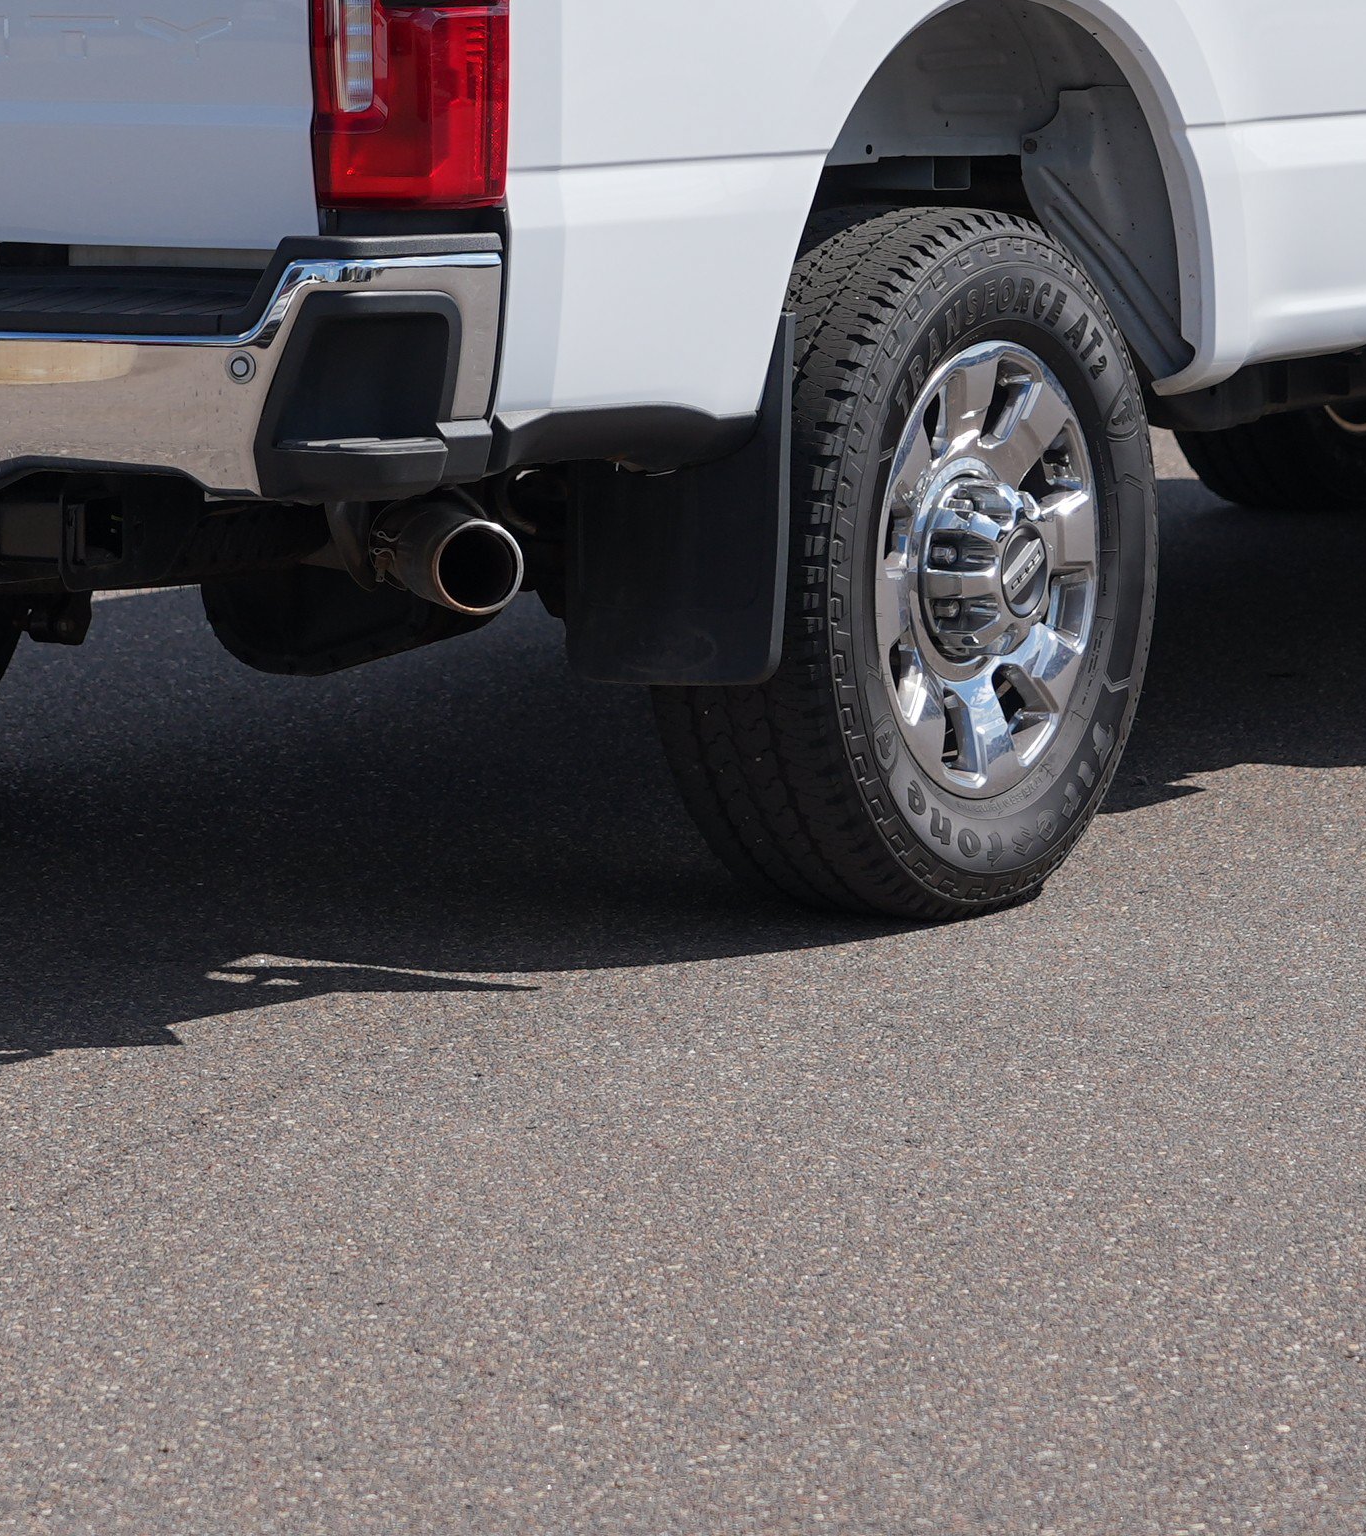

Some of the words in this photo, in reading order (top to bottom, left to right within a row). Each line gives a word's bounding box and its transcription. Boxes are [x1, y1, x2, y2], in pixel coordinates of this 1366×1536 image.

[895, 274, 1068, 418] TRANSFORCE
[1010, 549, 1041, 591] FORD
[906, 719, 1118, 868] Firestone
